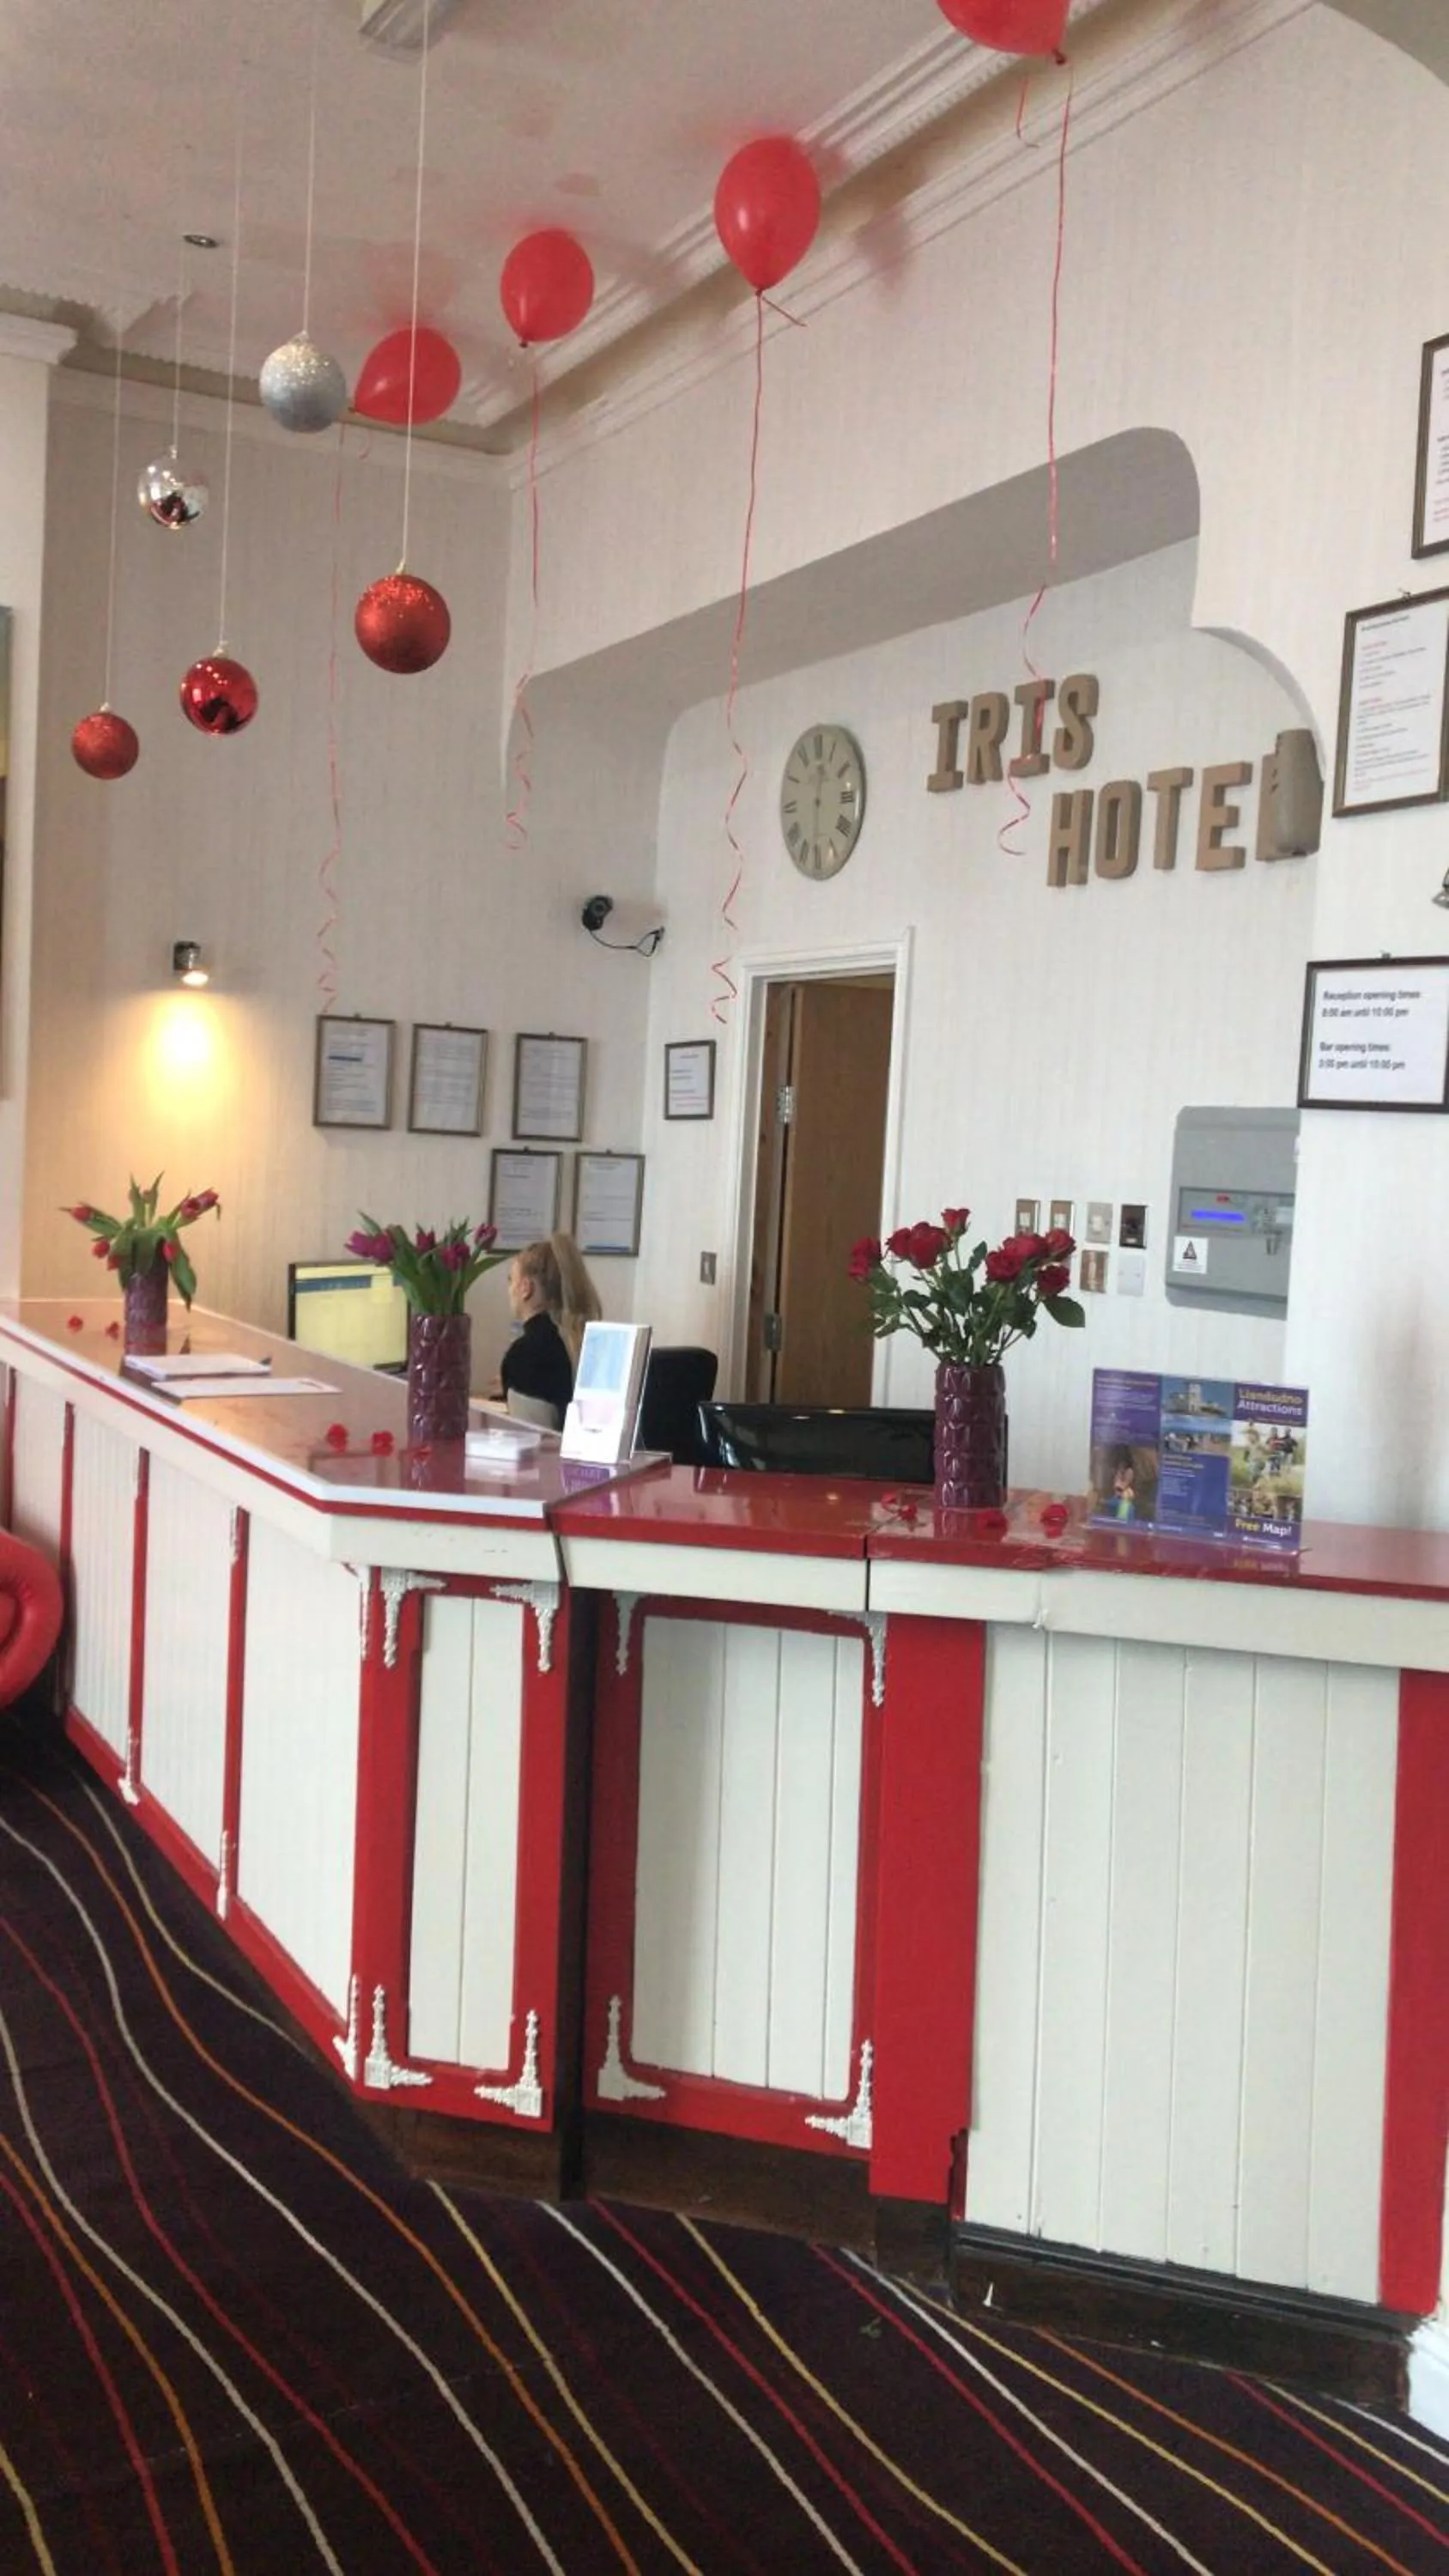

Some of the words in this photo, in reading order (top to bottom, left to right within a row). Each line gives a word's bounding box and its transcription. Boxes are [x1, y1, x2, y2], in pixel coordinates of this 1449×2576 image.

[927, 673, 1100, 793] IRIS
[1323, 990, 1361, 1000] Reception
[1363, 991, 1396, 1001] opening
[1397, 990, 1421, 999] times
[1340, 1009, 1353, 1018] am
[1354, 1007, 1370, 1018] until
[1372, 1007, 1394, 1018] 10:00
[1395, 1008, 1410, 1018] pm
[1319, 1042, 1333, 1052] Bar
[1335, 1042, 1367, 1054] opening
[1368, 1042, 1391, 1052] times
[1336, 1060, 1349, 1070] pm
[1350, 1059, 1367, 1069] until
[1391, 1061, 1406, 1071] pm
[1237, 1399, 1303, 1416] Attractions
[1235, 1517, 1260, 1532] Free
[1263, 1522, 1292, 1538] Map!
